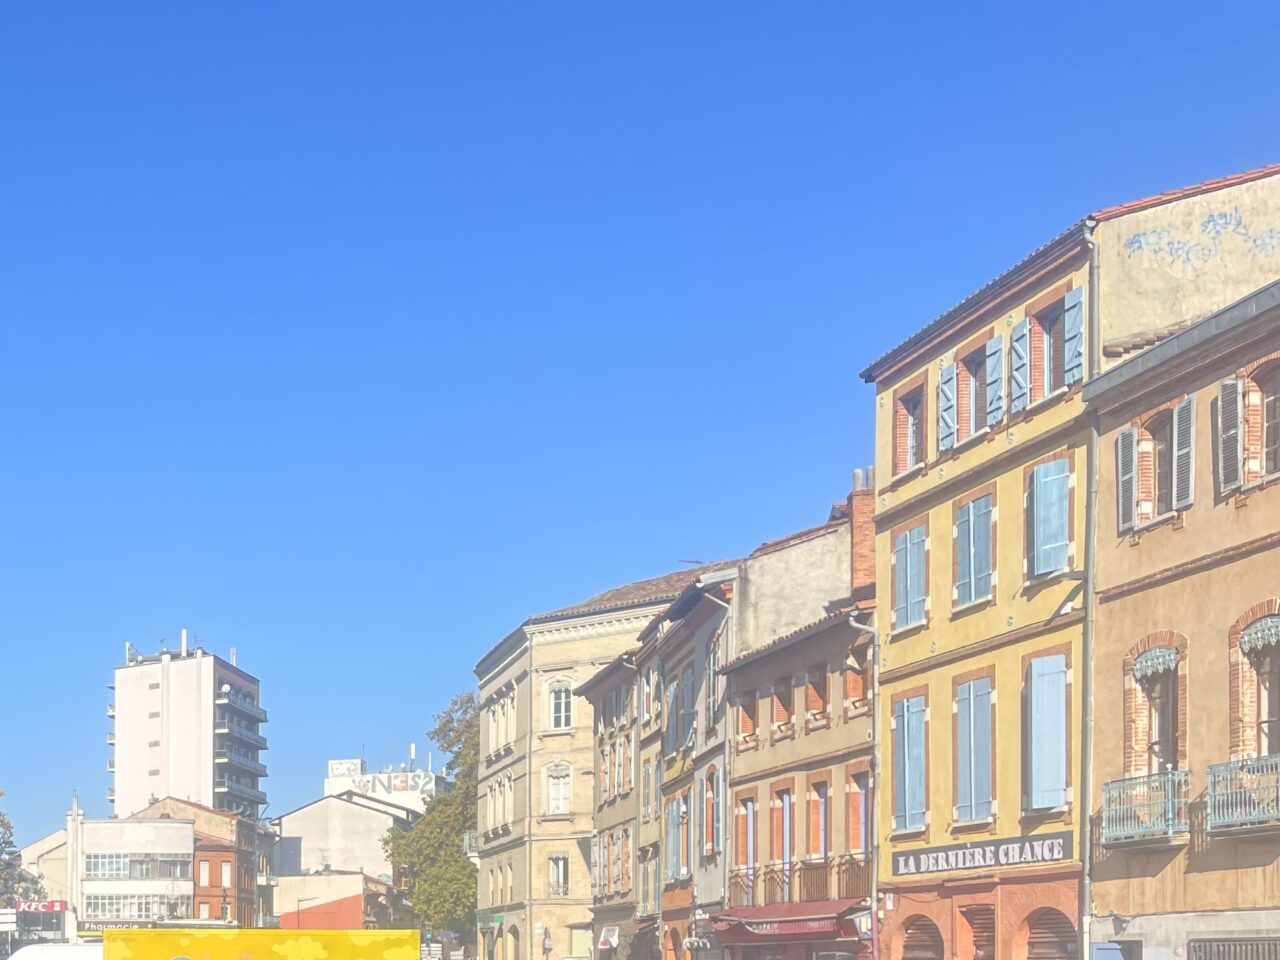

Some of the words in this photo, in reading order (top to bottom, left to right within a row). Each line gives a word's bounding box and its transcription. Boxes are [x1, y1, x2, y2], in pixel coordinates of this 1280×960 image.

[897, 855, 917, 875] LA
[919, 842, 996, 872] DERNIÈRE
[998, 838, 1064, 865] CHANCE
[18, 901, 49, 912] KFC
